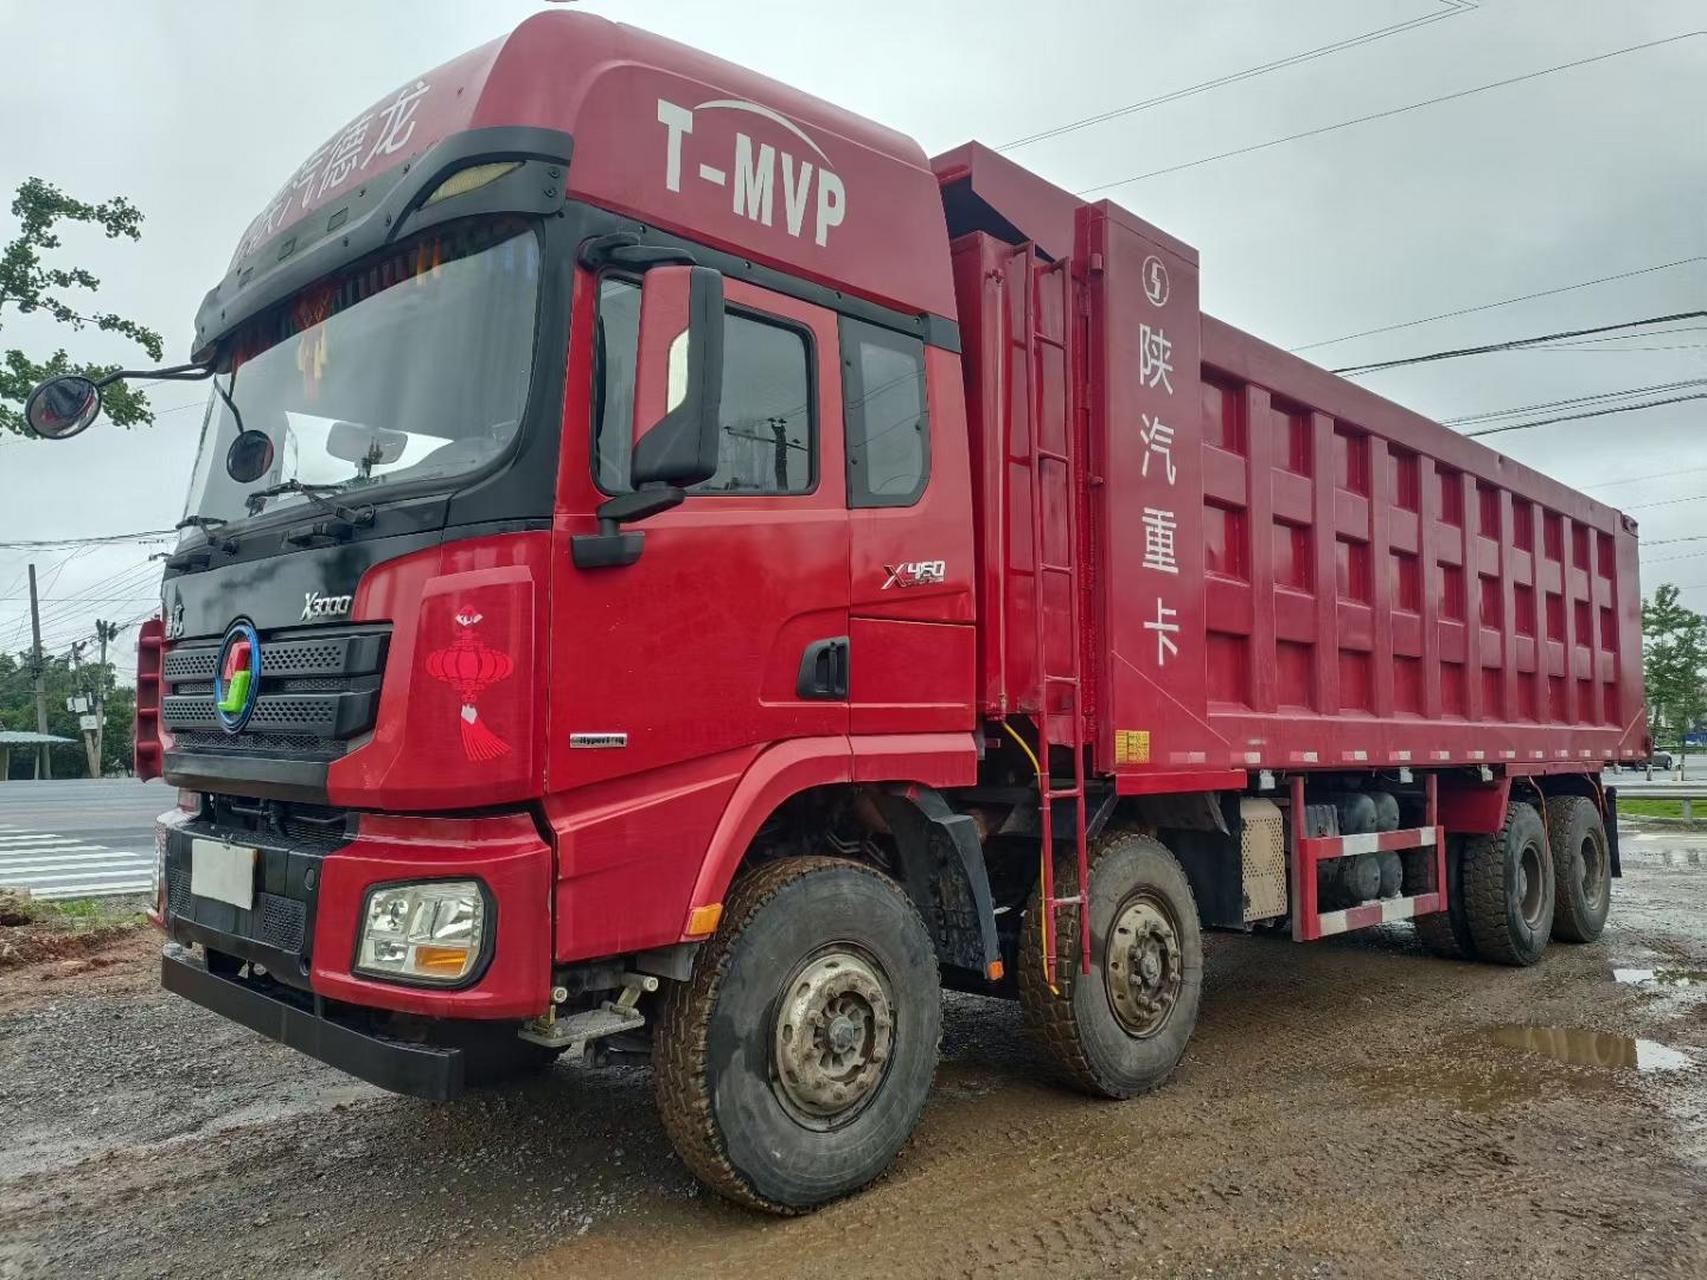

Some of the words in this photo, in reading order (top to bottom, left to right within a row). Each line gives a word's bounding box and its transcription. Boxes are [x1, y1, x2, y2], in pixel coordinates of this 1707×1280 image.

[657, 98, 846, 248] T-MVP
[1138, 322, 1180, 667] 陕汽重卡
[300, 591, 352, 620] X3000
